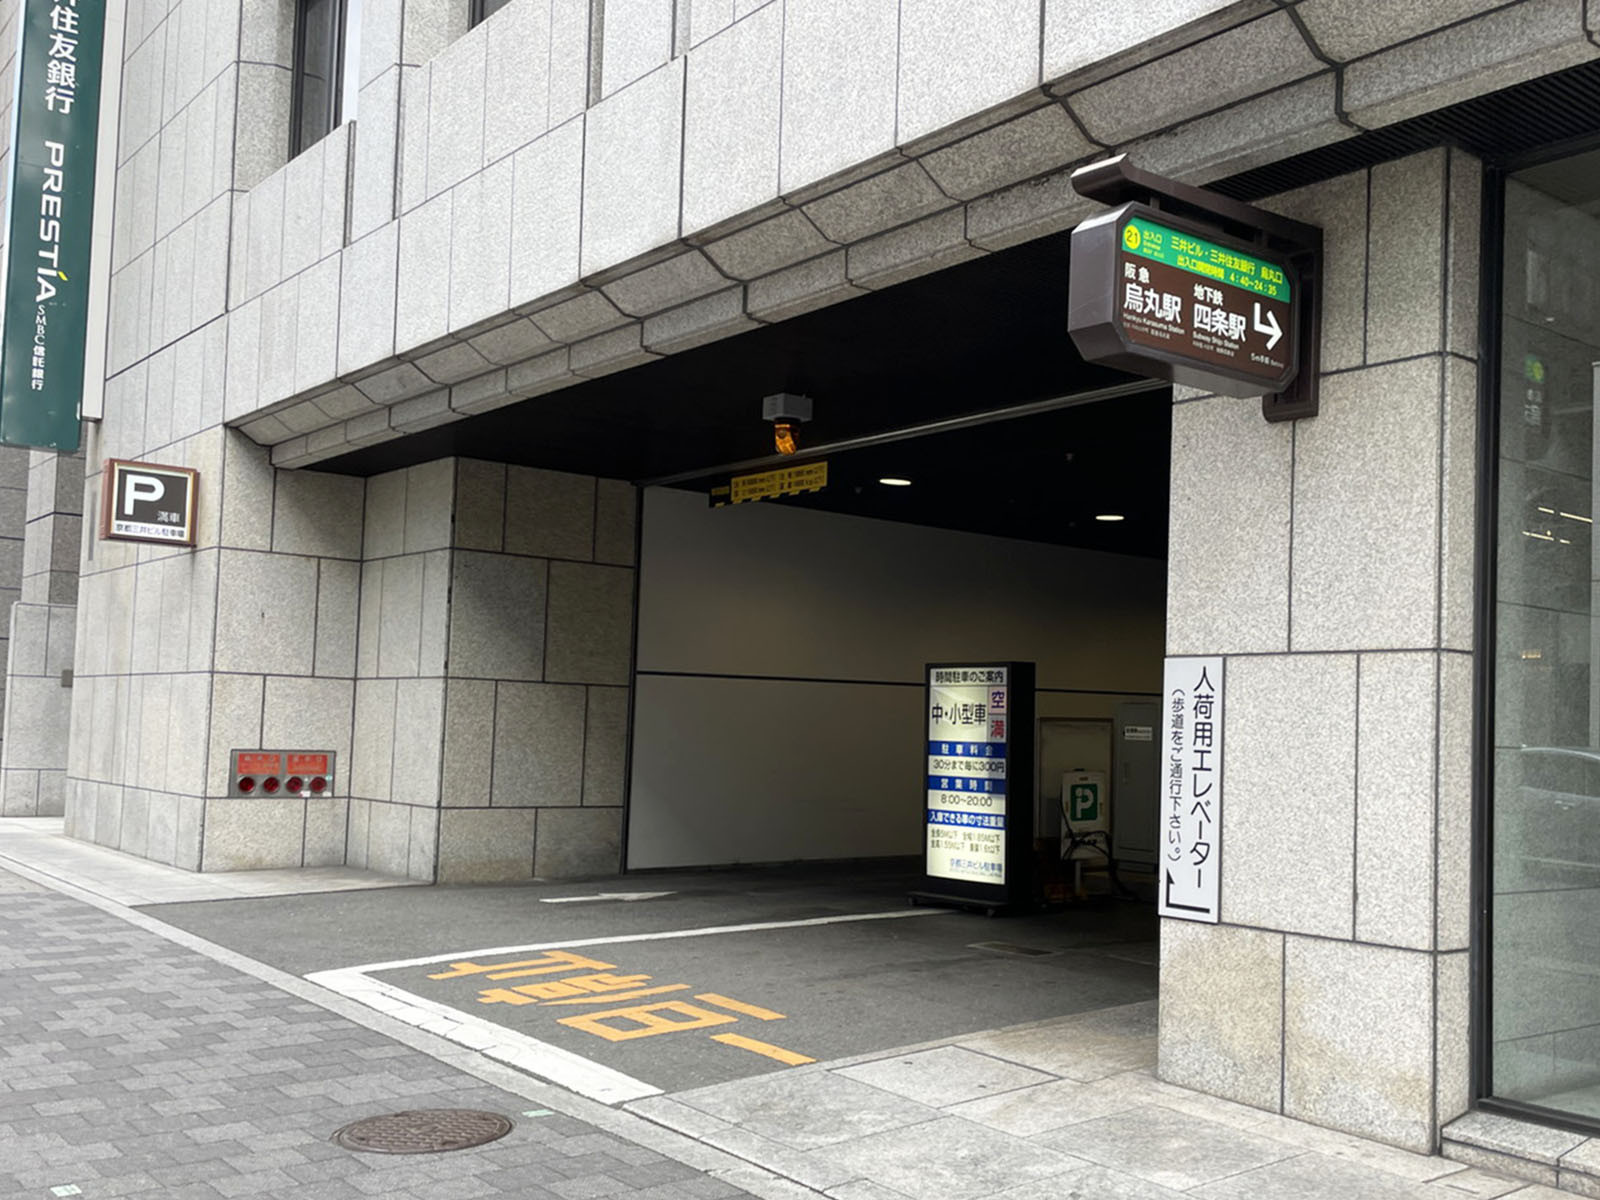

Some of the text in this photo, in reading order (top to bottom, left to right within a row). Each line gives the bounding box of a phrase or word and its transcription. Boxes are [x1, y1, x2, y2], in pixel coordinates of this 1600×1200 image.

[44, 0, 80, 114] 住友銀行
[1124, 261, 1149, 283] 阪急
[1123, 282, 1182, 324] 烏丸駅
[1193, 283, 1223, 306] 地下鉄
[1193, 303, 1246, 342] 四条駅
[124, 474, 165, 516] P
[935, 671, 1004, 684] 時間駐車のご案内
[991, 690, 1005, 709] 空
[932, 703, 987, 725] 中・小型車
